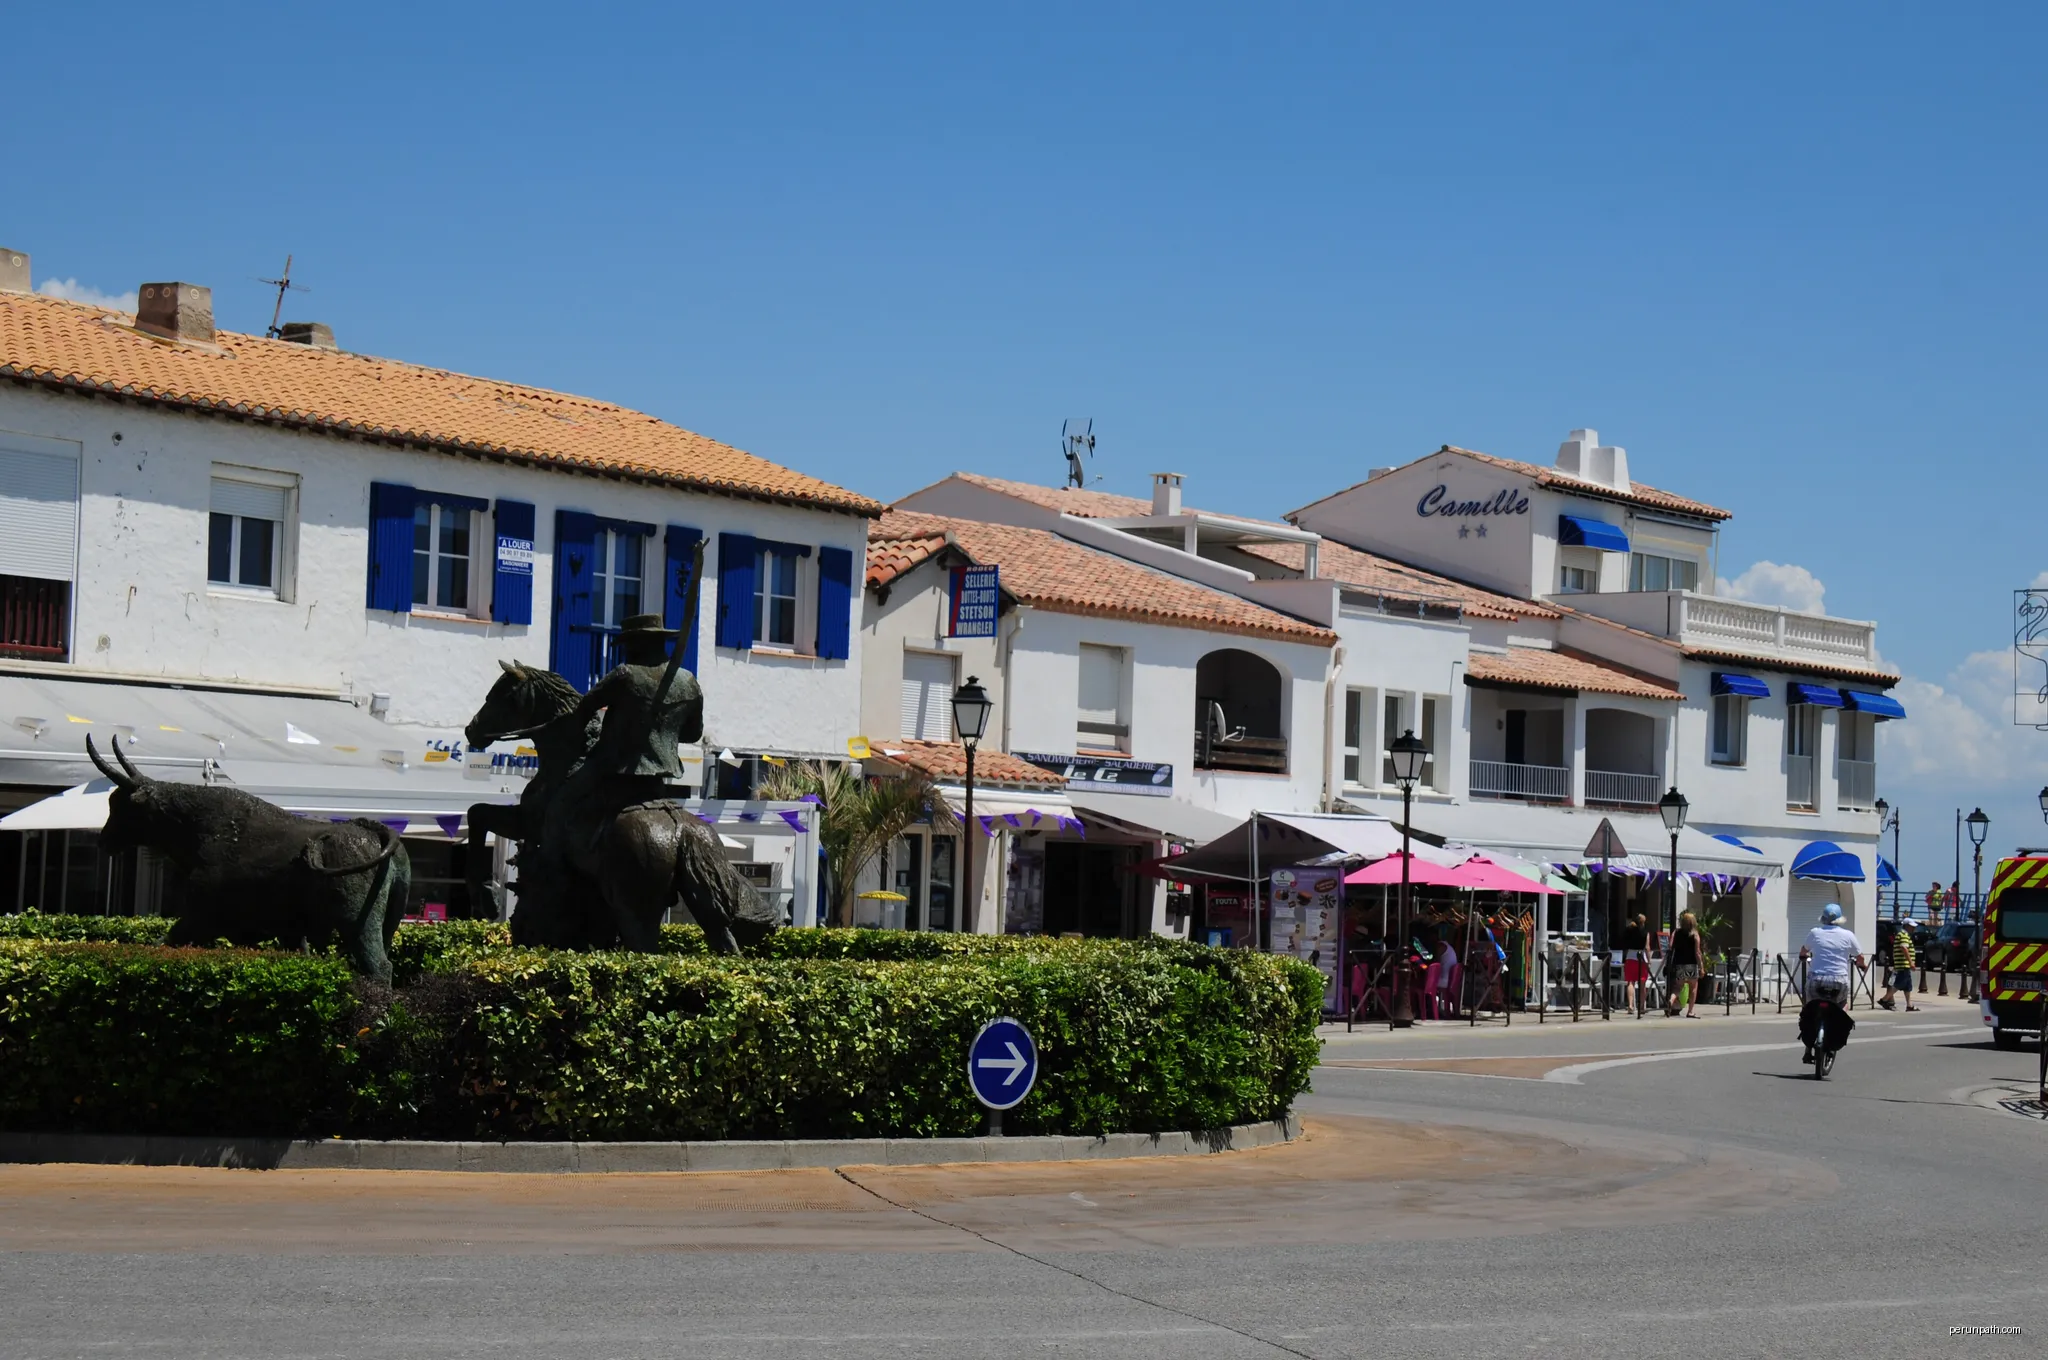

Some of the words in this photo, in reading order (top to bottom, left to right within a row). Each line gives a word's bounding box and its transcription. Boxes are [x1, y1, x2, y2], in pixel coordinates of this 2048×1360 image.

[1416, 484, 1530, 518] Camille
[508, 540, 531, 550] LOUER
[965, 574, 995, 588] SELLERIE
[959, 605, 994, 620] STETSON
[956, 621, 994, 636] WRANGLER
[1104, 759, 1157, 771] SALADERIE
